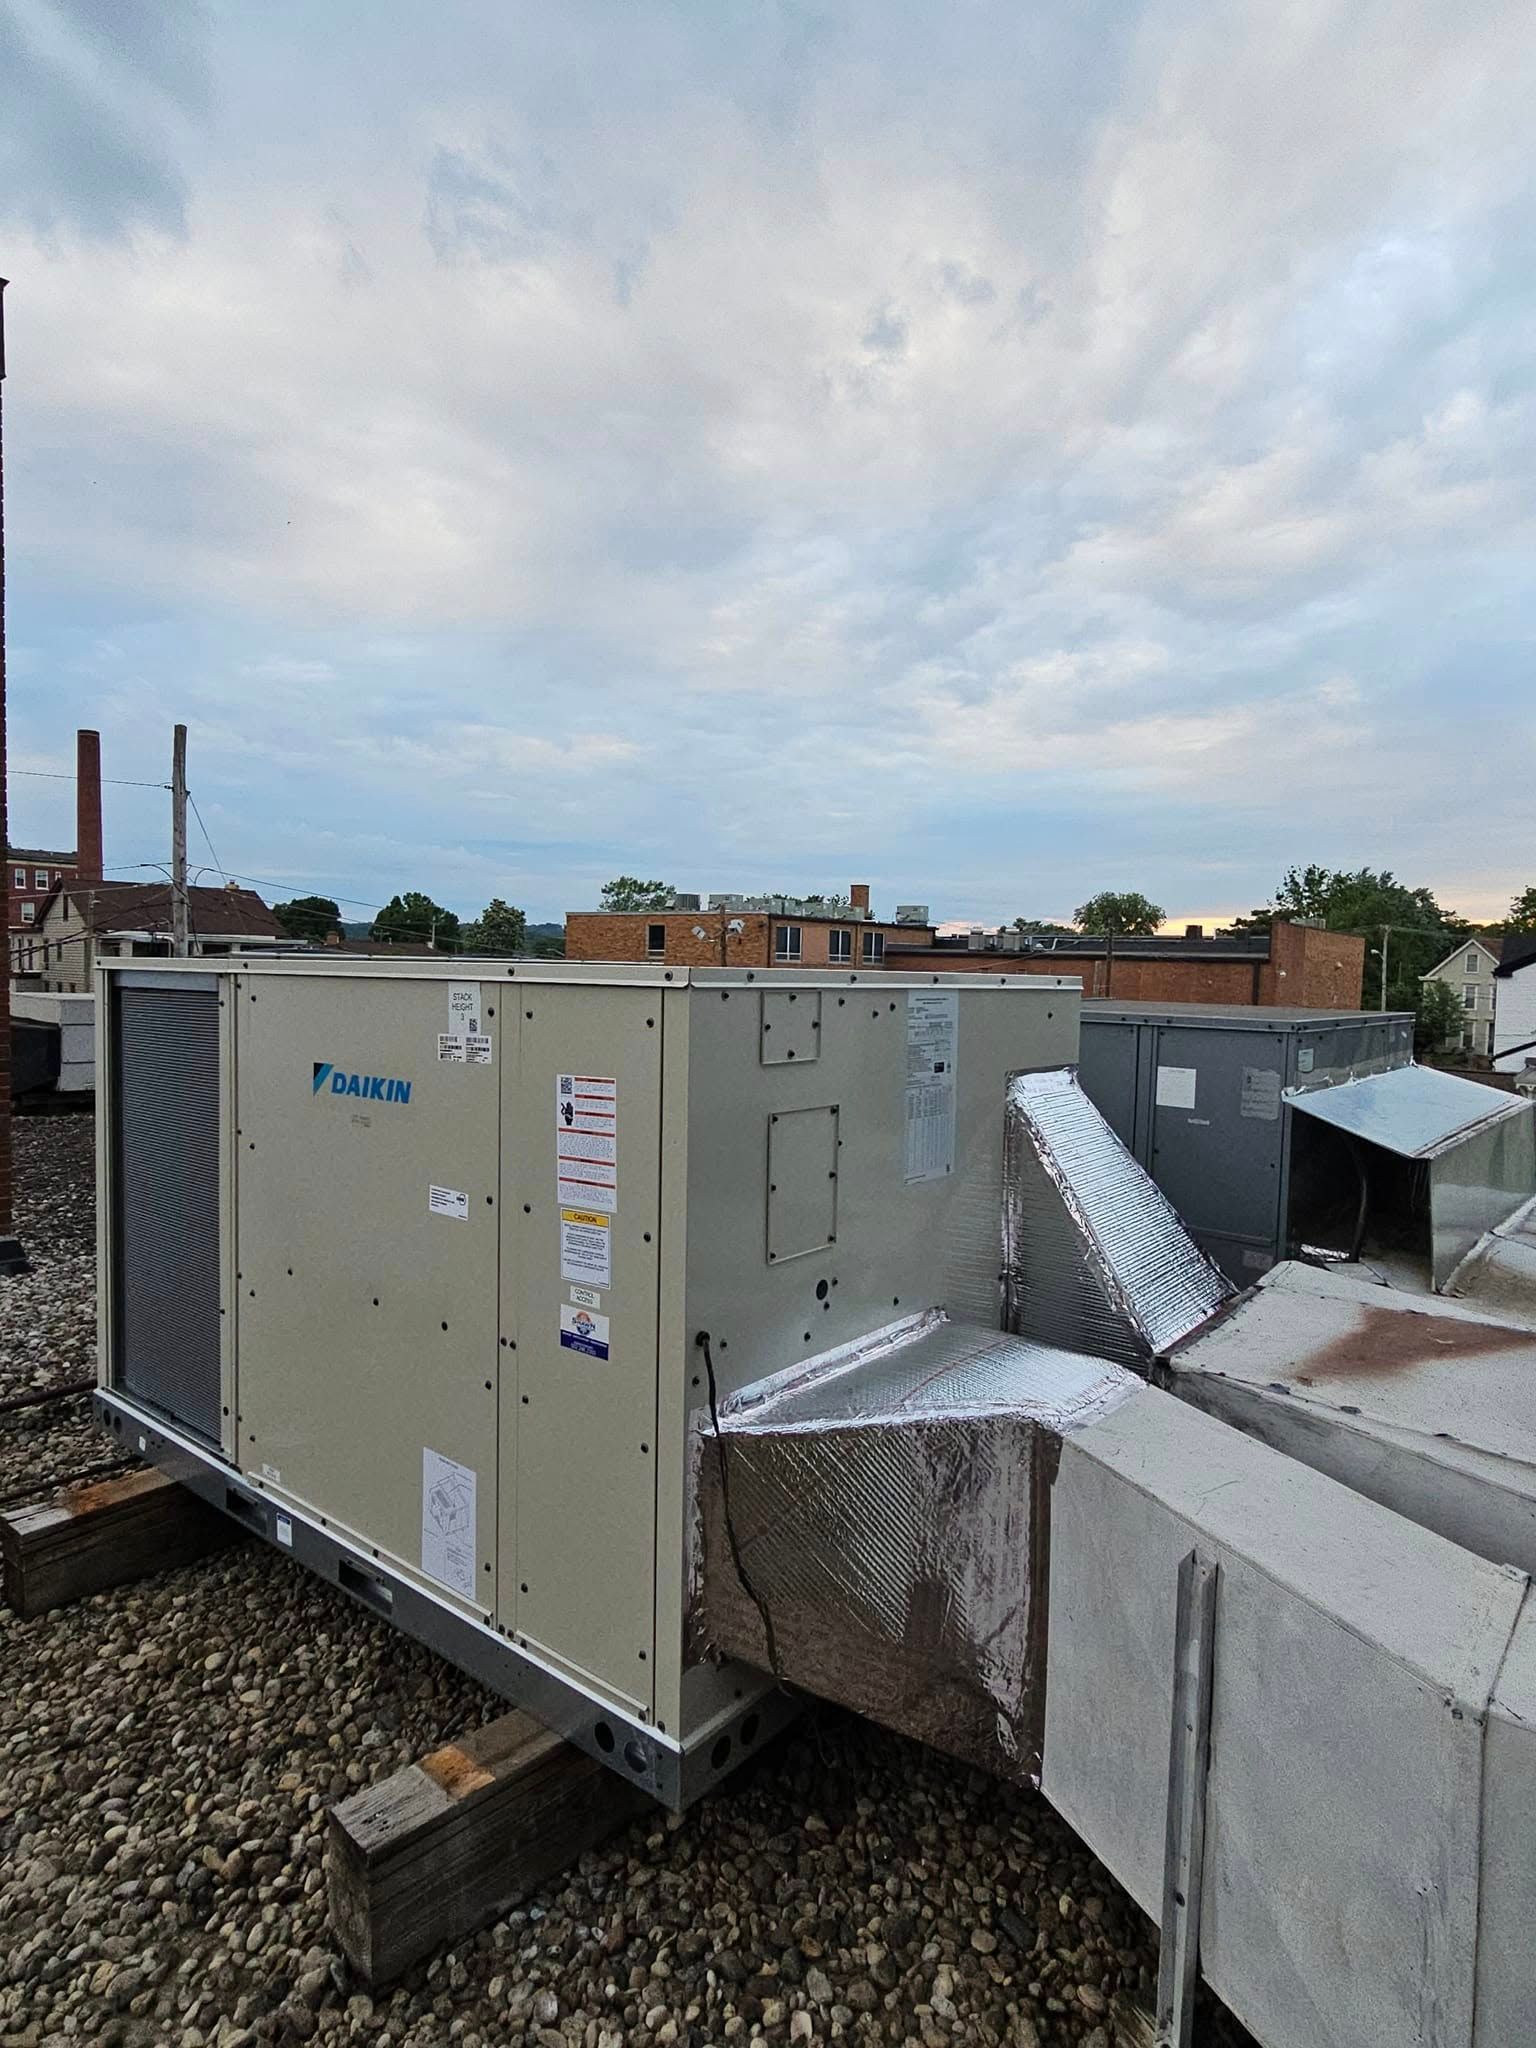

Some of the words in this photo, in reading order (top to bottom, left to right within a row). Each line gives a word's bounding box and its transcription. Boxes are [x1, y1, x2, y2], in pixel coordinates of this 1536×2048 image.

[452, 992, 473, 1001] STACK
[451, 1003, 473, 1011] HEIGHT
[331, 1072, 412, 1104] DAIKIN
[573, 1213, 597, 1223] CAUTION
[574, 1288, 594, 1298] CONTROL
[576, 1295, 593, 1305] ACCESS
